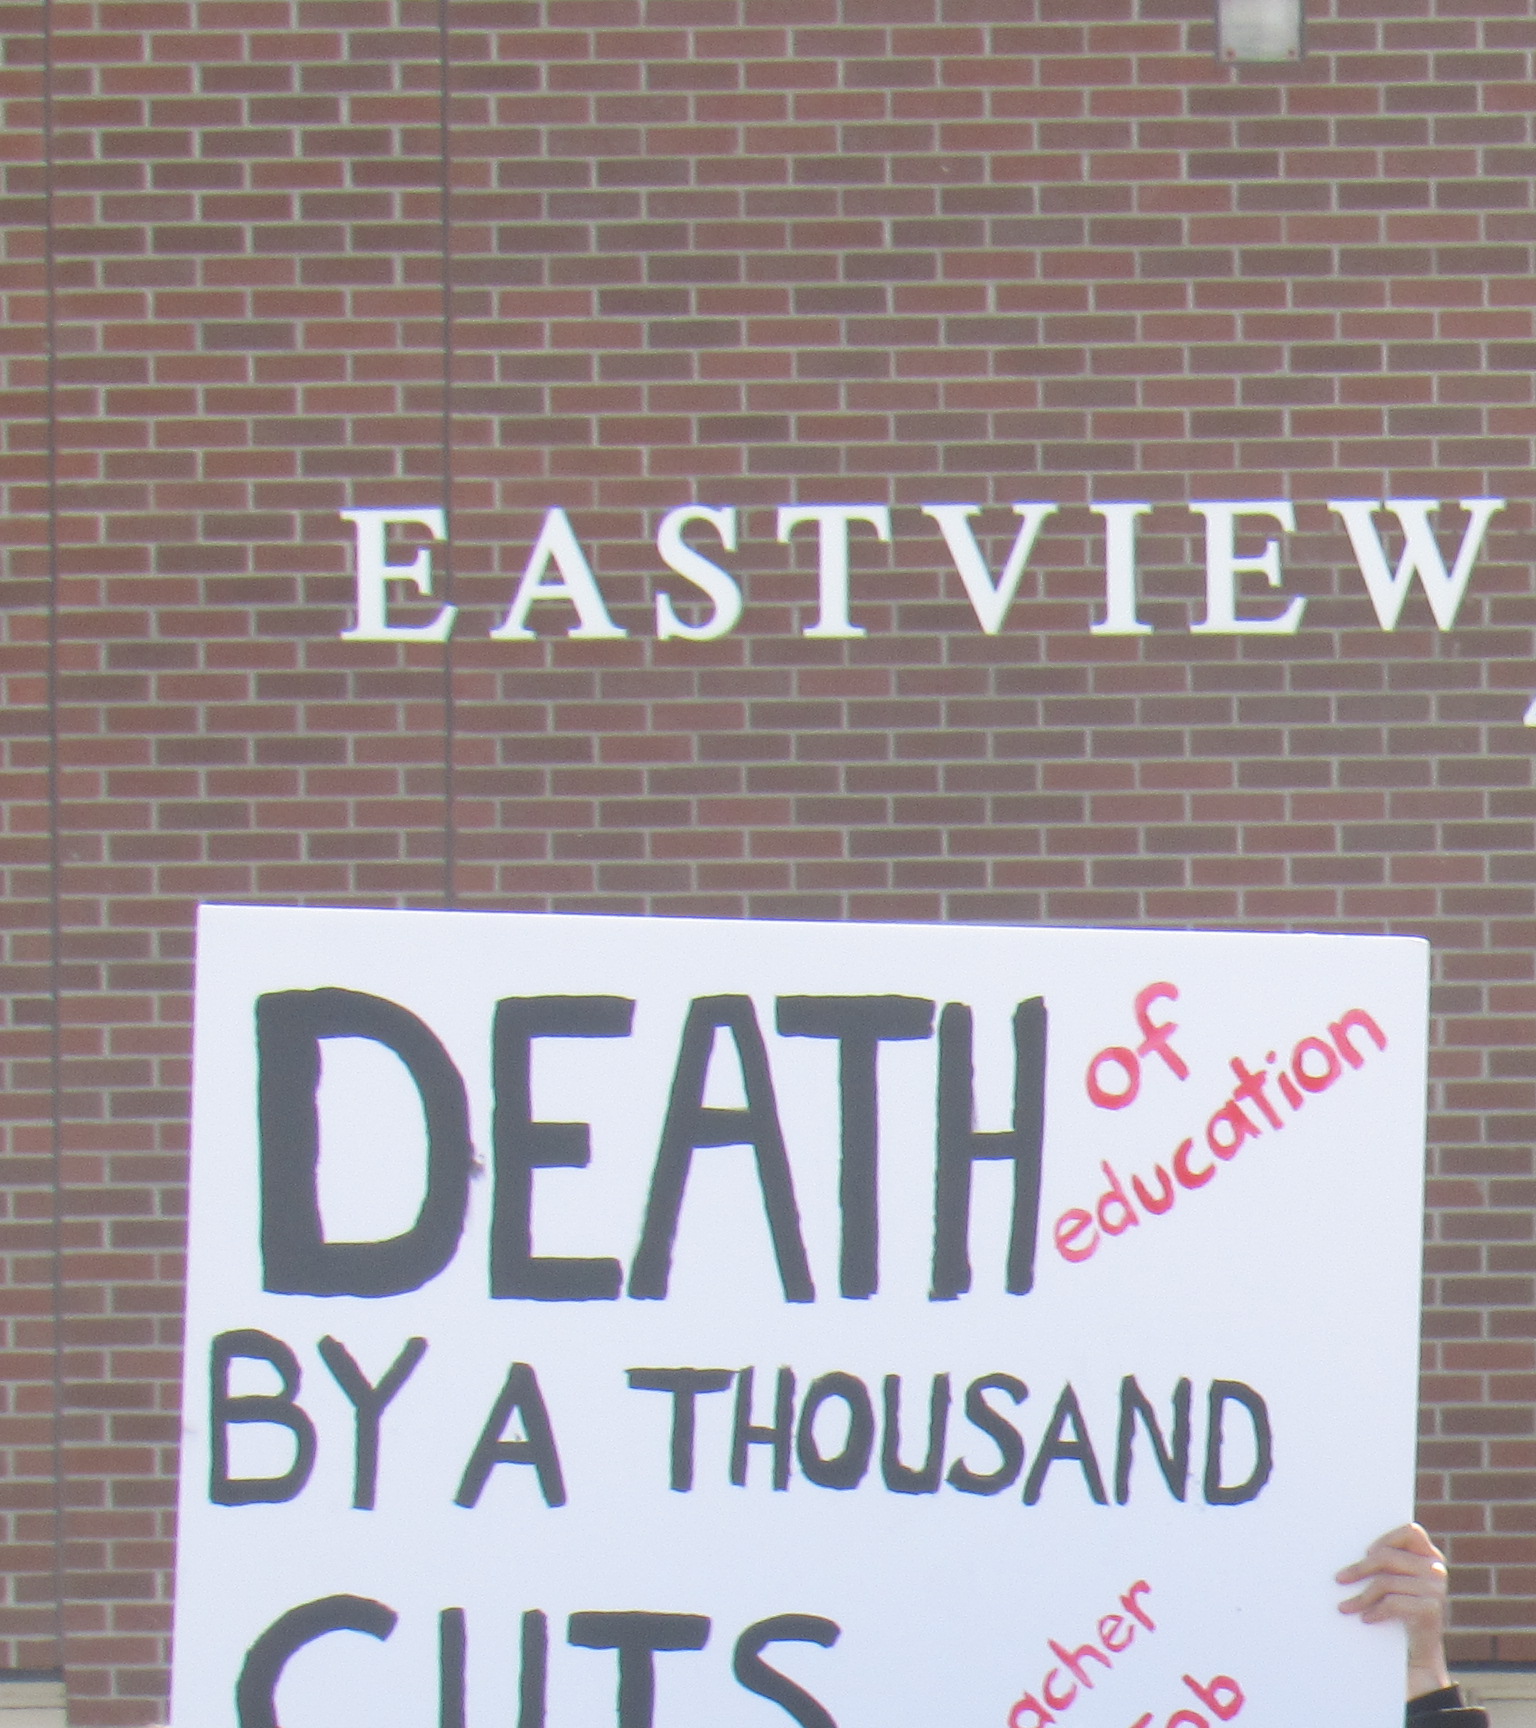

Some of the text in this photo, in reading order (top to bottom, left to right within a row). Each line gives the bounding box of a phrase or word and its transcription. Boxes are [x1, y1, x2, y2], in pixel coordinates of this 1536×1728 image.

[340, 498, 1507, 640] EASTVIEW
[1054, 1007, 1389, 1263] education
[1085, 981, 1191, 1112] of
[255, 987, 1047, 1303] DEATH
[208, 1328, 1274, 1511] BY A THOUSAND
